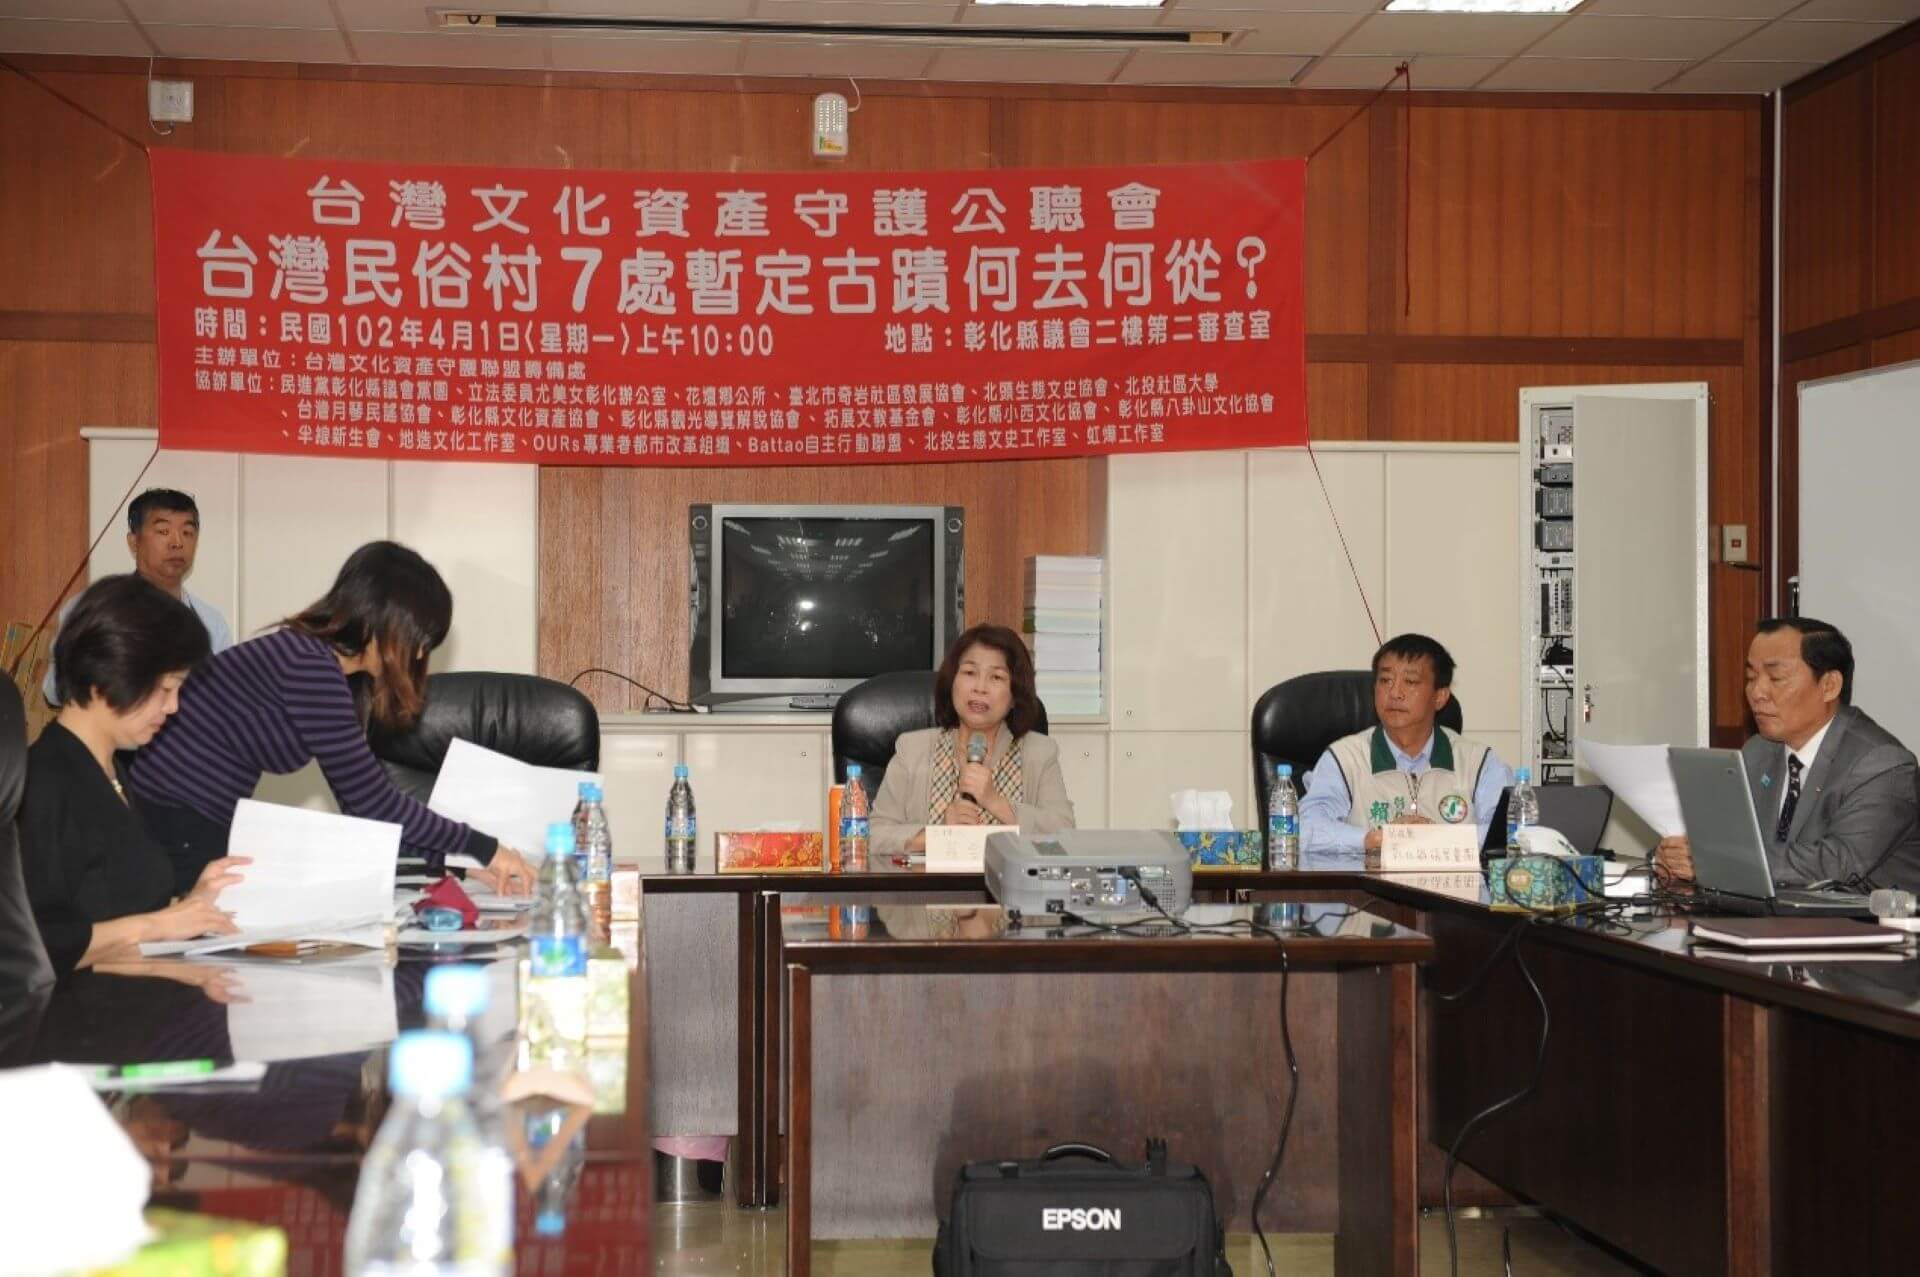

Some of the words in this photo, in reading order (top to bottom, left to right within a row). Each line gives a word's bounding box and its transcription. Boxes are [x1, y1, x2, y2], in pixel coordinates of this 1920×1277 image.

[306, 174, 1162, 239] 台灣文化資產守護公聽會
[1042, 1208, 1121, 1230] EPSON
